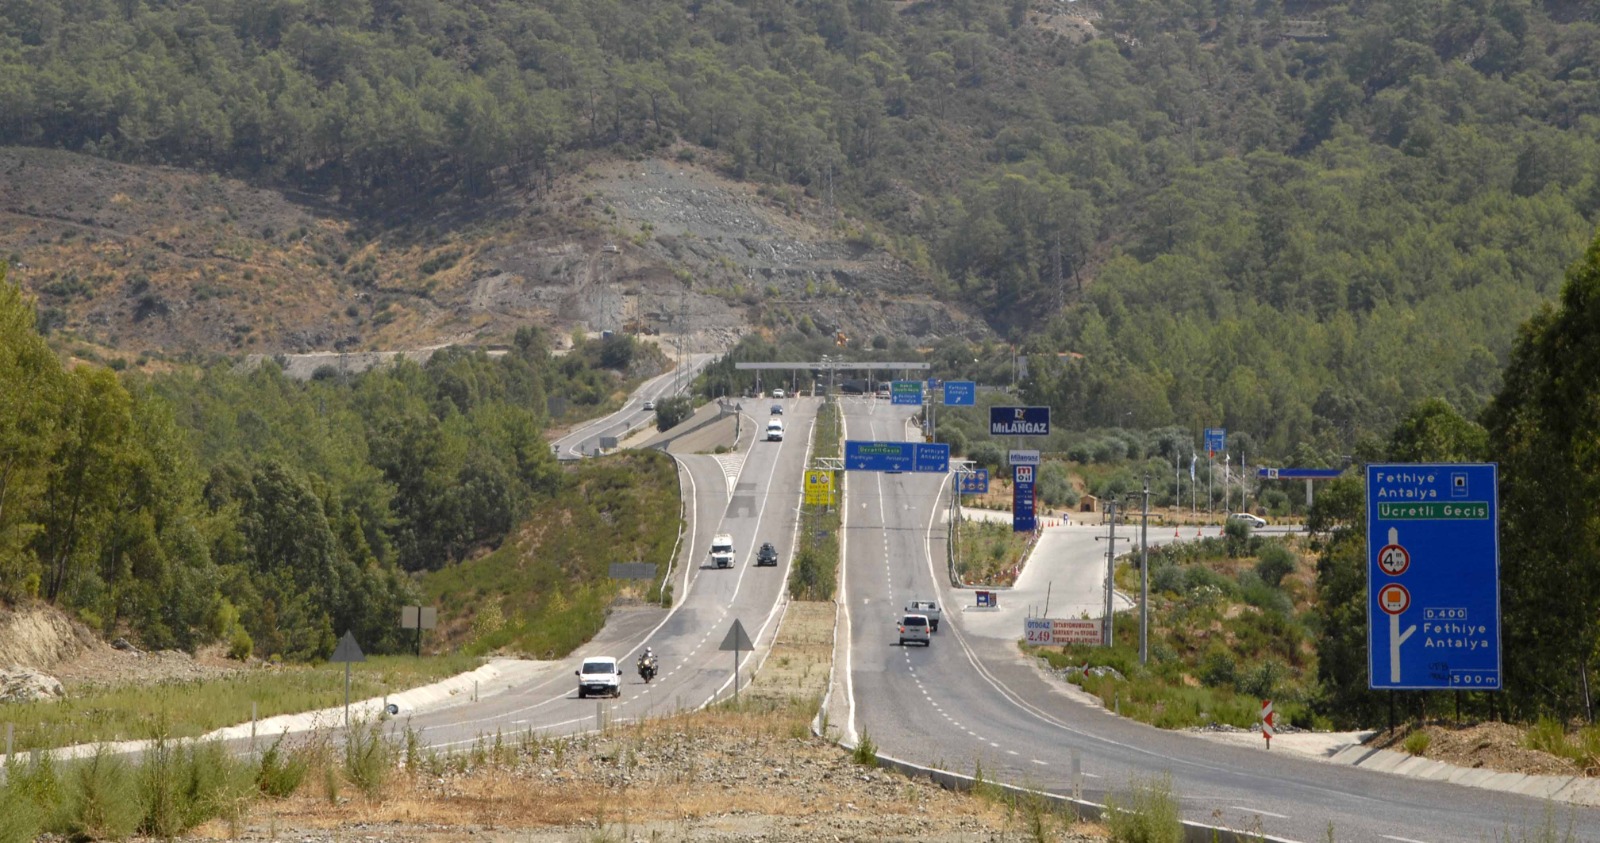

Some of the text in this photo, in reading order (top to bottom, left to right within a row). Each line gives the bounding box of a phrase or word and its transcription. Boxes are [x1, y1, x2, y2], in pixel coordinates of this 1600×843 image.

[1377, 472, 1435, 485] Fethiye
[1378, 487, 1437, 499] Antalya
[1381, 504, 1485, 517] Ücretli Geçiş
[1427, 610, 1464, 618] D.400
[1424, 623, 1486, 636] Fethiye
[1028, 631, 1050, 642] 2.49
[1424, 637, 1488, 650] Antalya
[1453, 675, 1482, 683] 500
